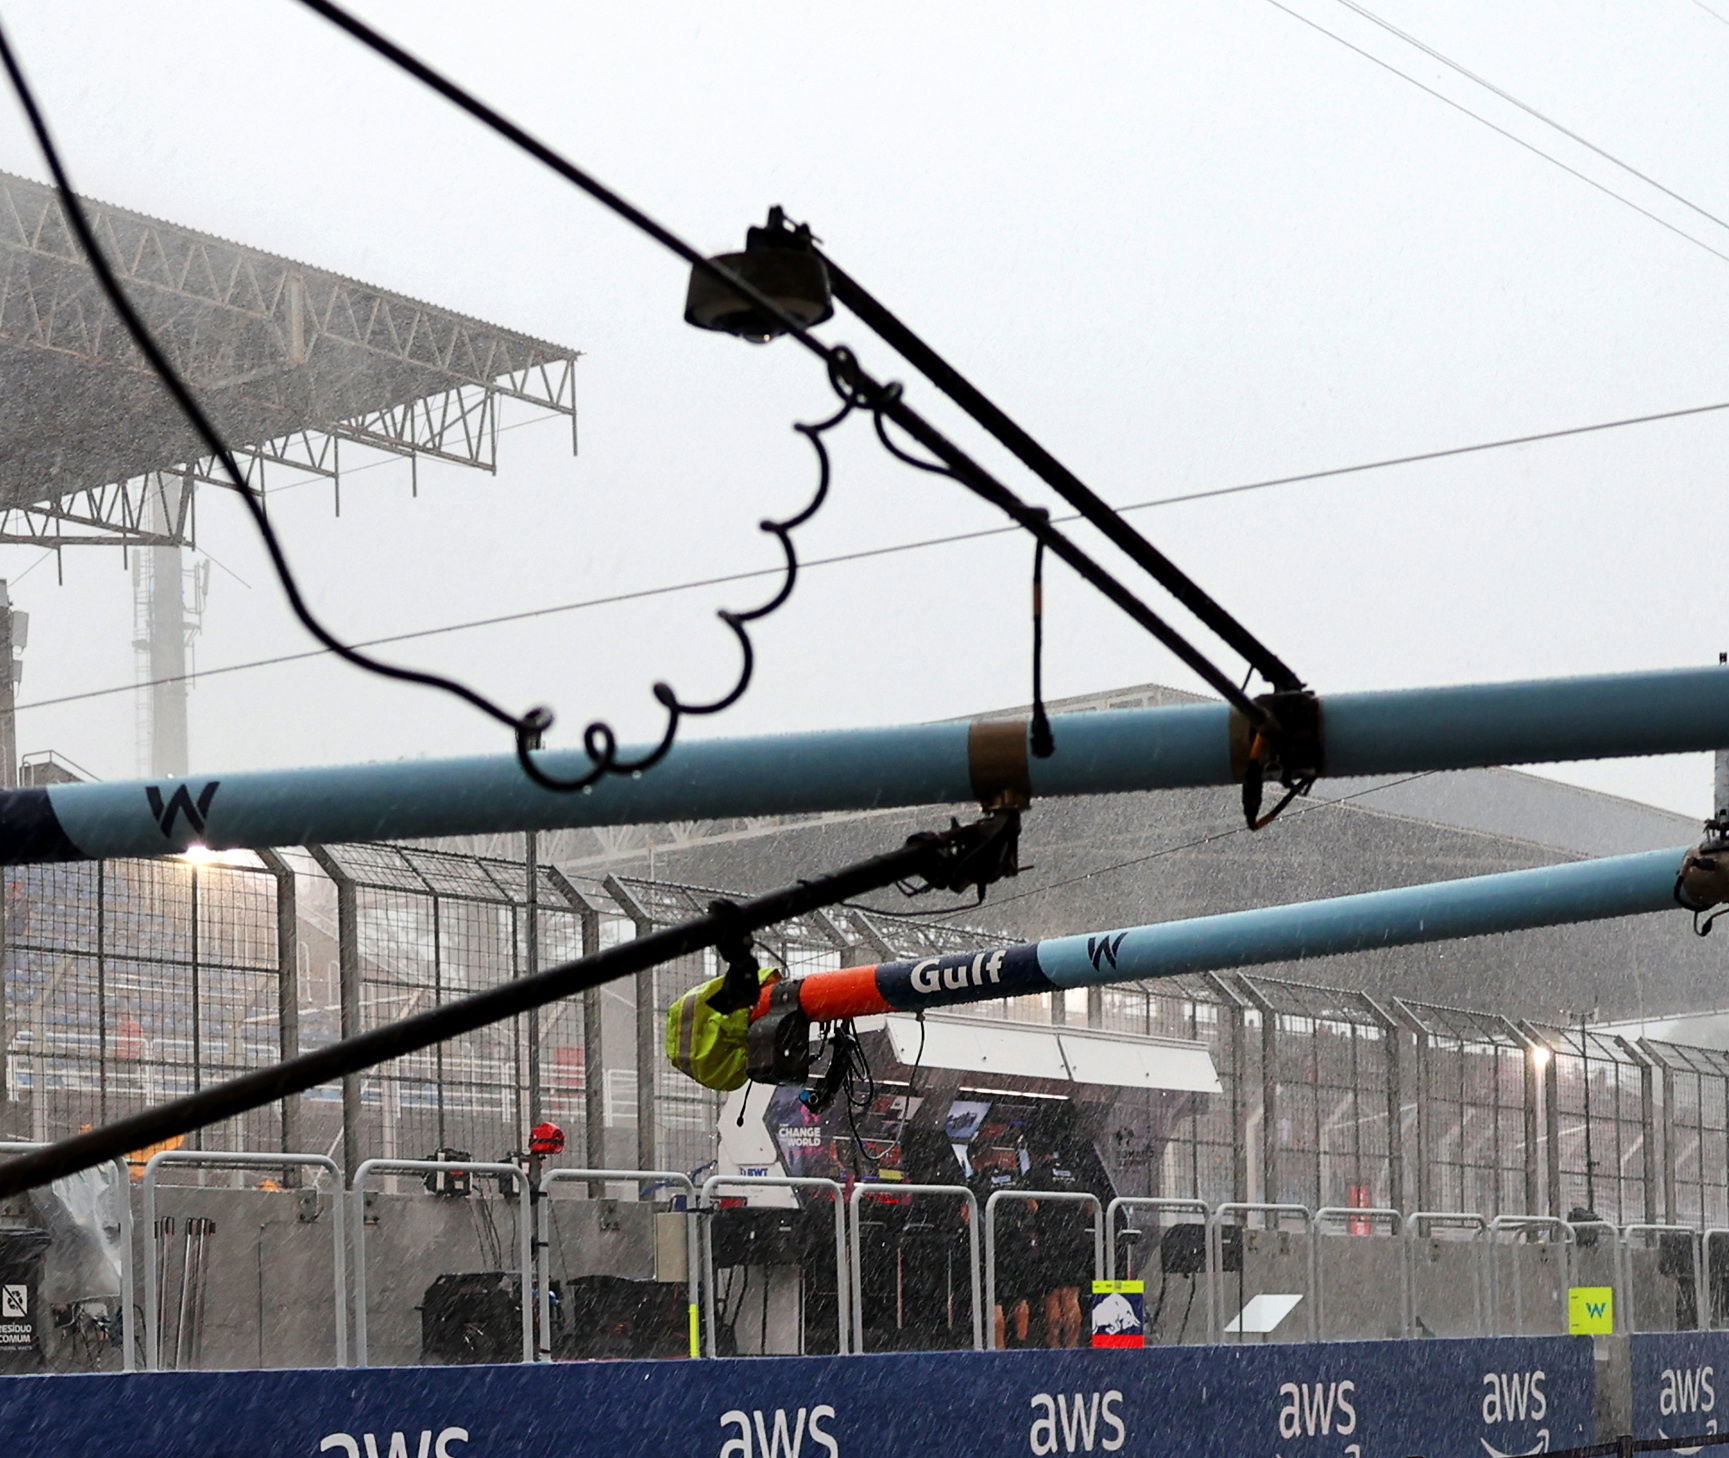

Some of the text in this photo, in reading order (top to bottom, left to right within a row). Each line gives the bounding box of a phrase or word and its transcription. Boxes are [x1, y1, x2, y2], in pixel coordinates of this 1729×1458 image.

[145, 781, 220, 838] W
[910, 949, 1007, 994] Gulf
[1087, 931, 1127, 972] W
[779, 1127, 821, 1138] CHANGE
[788, 1137, 821, 1147] WORLD
[1279, 1380, 1356, 1439] aws
[1483, 1370, 1546, 1424] aws
[1660, 1366, 1714, 1415] aws
[1030, 1390, 1125, 1455] aws
